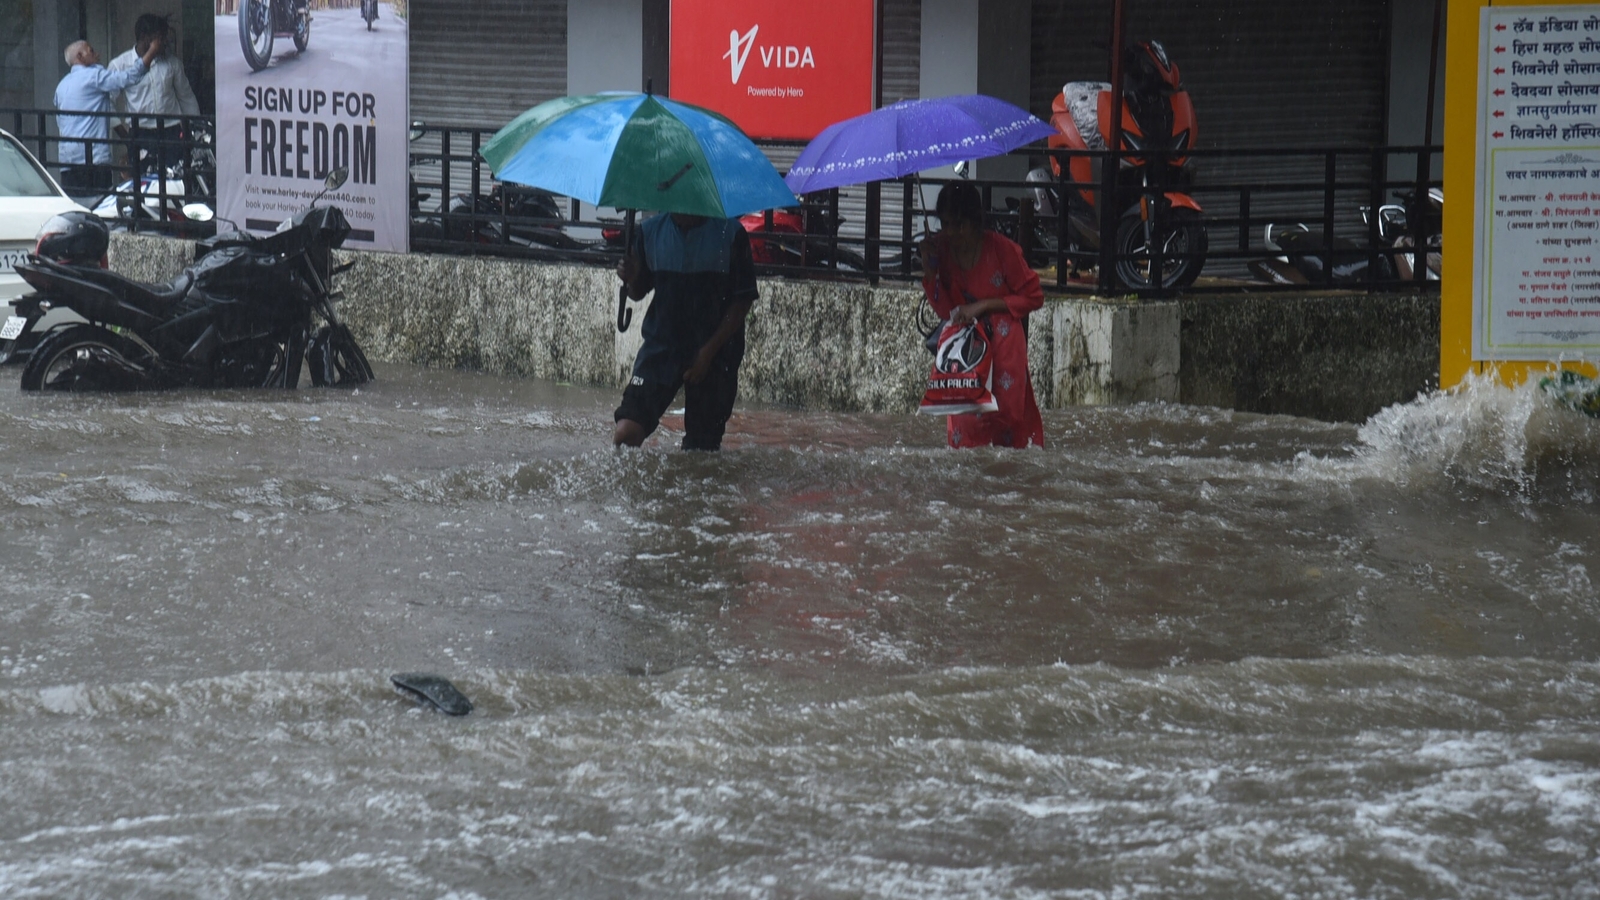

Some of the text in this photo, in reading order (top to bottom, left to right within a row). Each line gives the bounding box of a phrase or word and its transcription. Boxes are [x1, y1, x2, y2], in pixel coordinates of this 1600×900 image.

[1539, 15, 1578, 33] इंडिया
[1583, 14, 1600, 31] सो
[1513, 39, 1538, 56] हिरा
[1543, 42, 1574, 56] महल
[760, 46, 815, 68] VIDA
[1512, 60, 1559, 76] शिवनेरी
[747, 85, 803, 98] Powered by Hero
[1511, 82, 1553, 98] देवदया
[244, 86, 376, 118] SIGN UP FOR
[1510, 124, 1557, 140] शिवनेरी
[244, 117, 376, 185] FREEDOM
[245, 184, 260, 195] Visit
[368, 196, 376, 204] to
[245, 199, 261, 209] book
[262, 203, 276, 212] your
[355, 210, 376, 221] today.
[0, 254, 26, 269] 121
